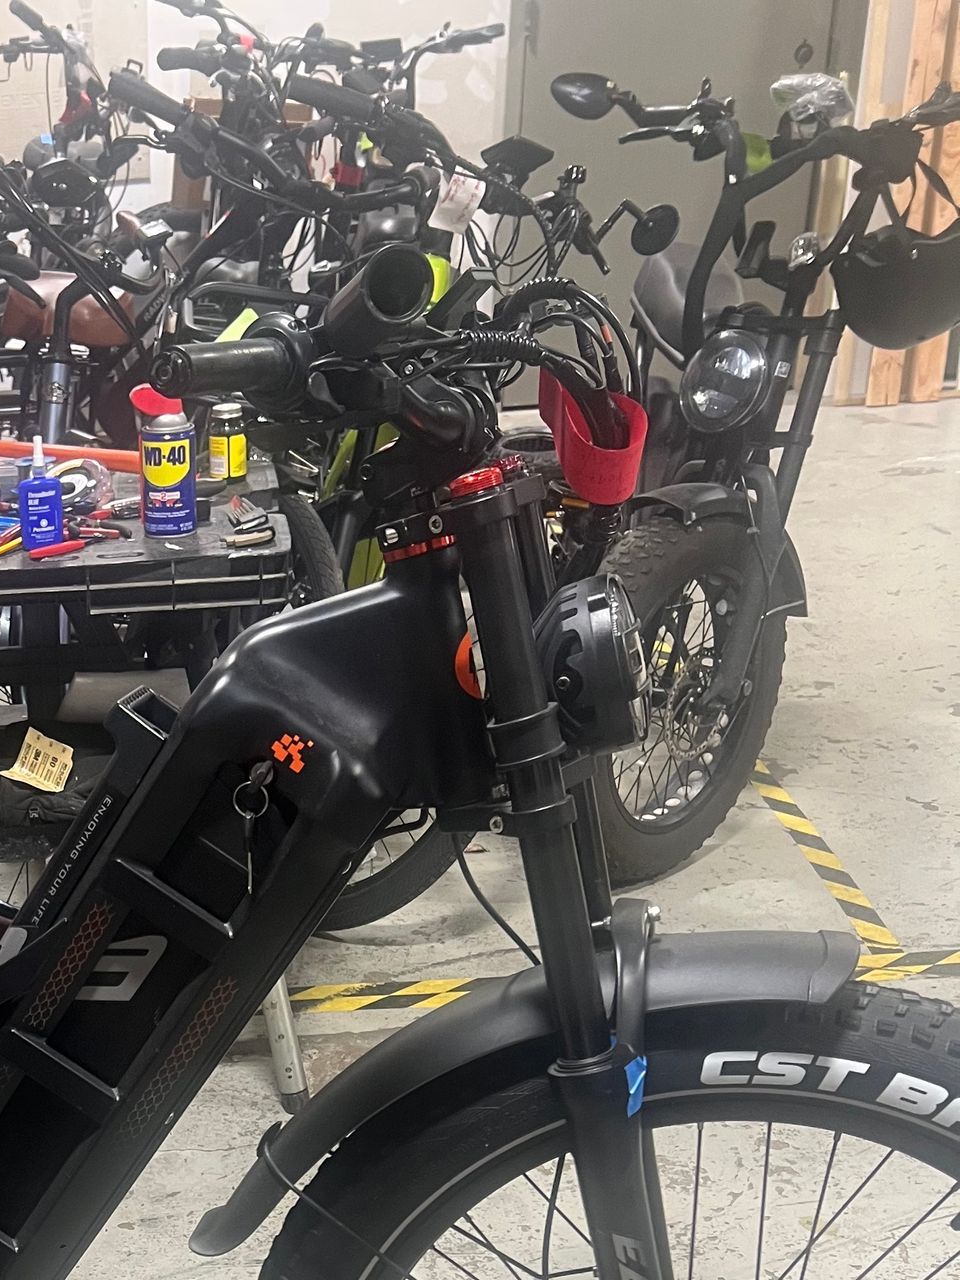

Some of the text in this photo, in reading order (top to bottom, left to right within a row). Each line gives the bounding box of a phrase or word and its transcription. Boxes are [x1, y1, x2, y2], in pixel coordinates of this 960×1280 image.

[143, 445, 186, 467] WD-40
[31, 796, 112, 925] ENJOYING YOUR LIFE
[700, 1051, 871, 1092] CST
